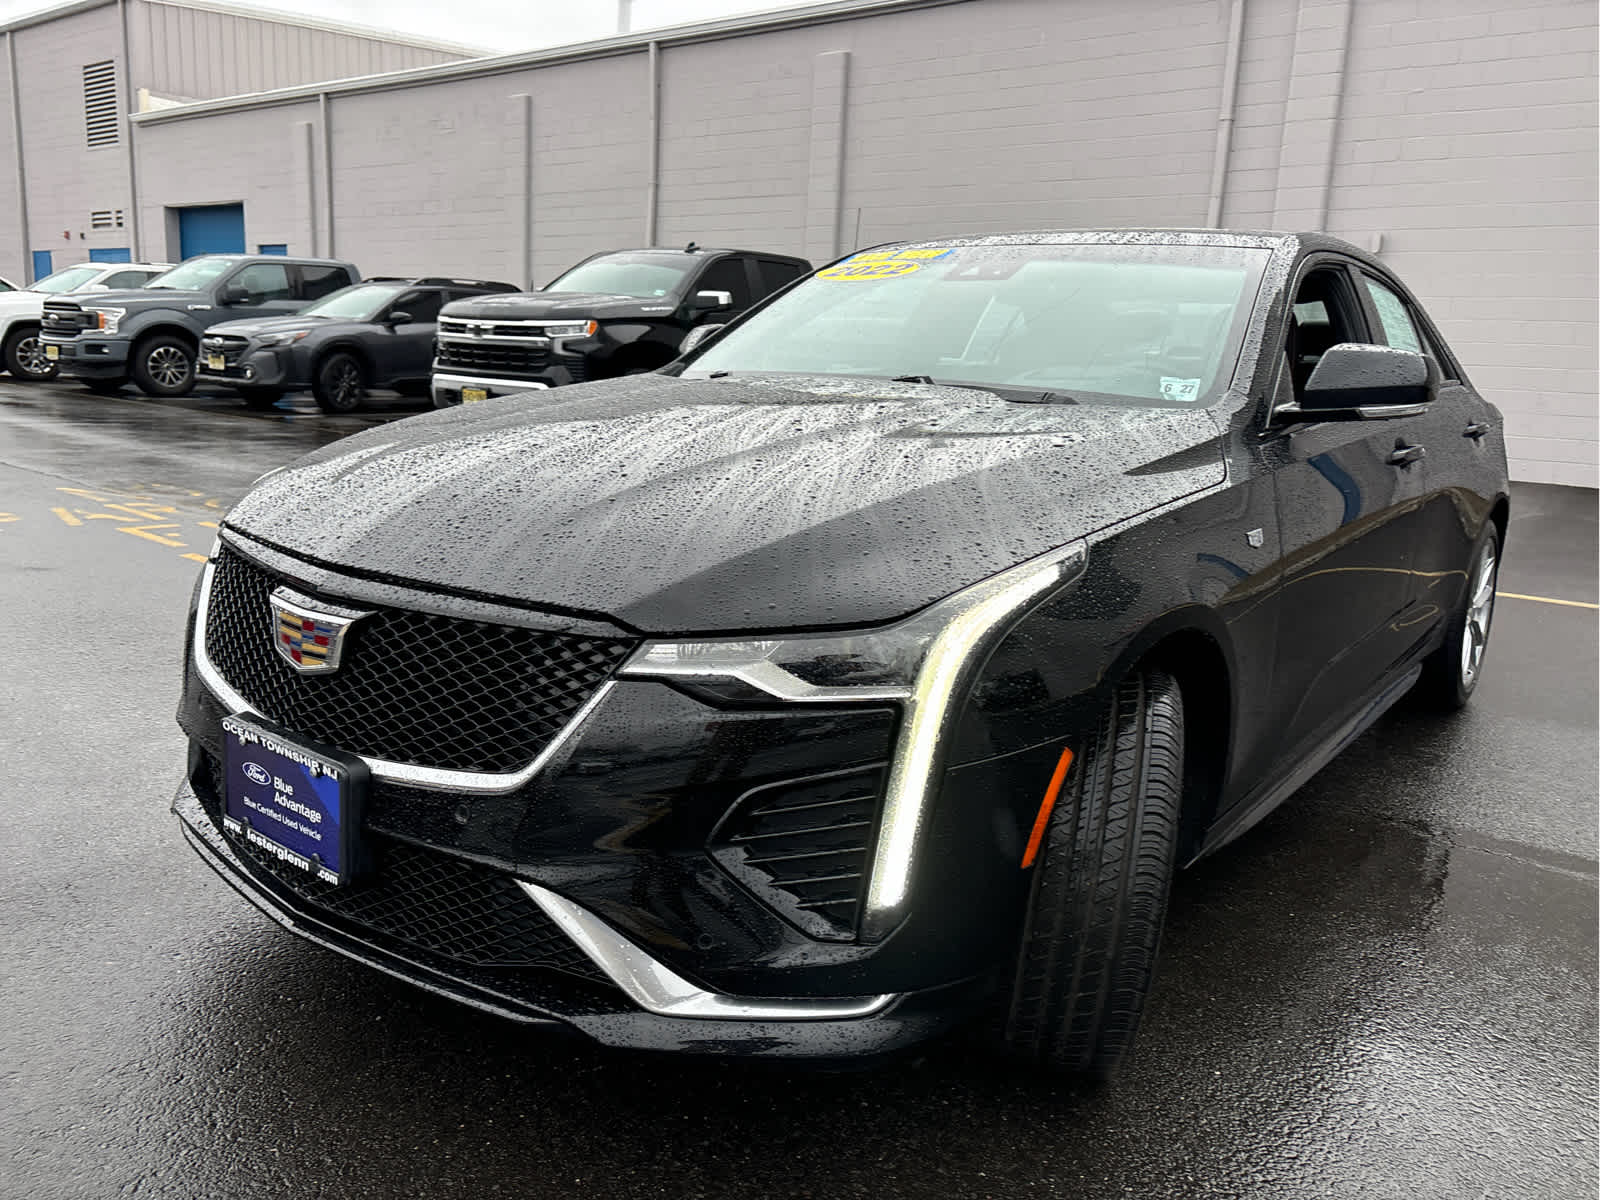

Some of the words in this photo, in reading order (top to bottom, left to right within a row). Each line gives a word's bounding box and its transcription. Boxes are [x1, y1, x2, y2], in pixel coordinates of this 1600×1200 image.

[823, 263, 914, 277] 2022
[1164, 383, 1173, 393] 6
[1179, 384, 1195, 394] 27
[222, 721, 259, 744] OCEAN
[322, 765, 338, 781] NJ
[247, 764, 267, 782] Ford
[273, 776, 294, 796] Blue
[243, 795, 257, 810] Blue
[256, 803, 282, 822] Certified
[282, 815, 298, 830] Used
[298, 823, 322, 841] Vehicle
[274, 791, 322, 823] Advantage
[246, 828, 310, 871] lesterglenn
[317, 869, 338, 886] .com
